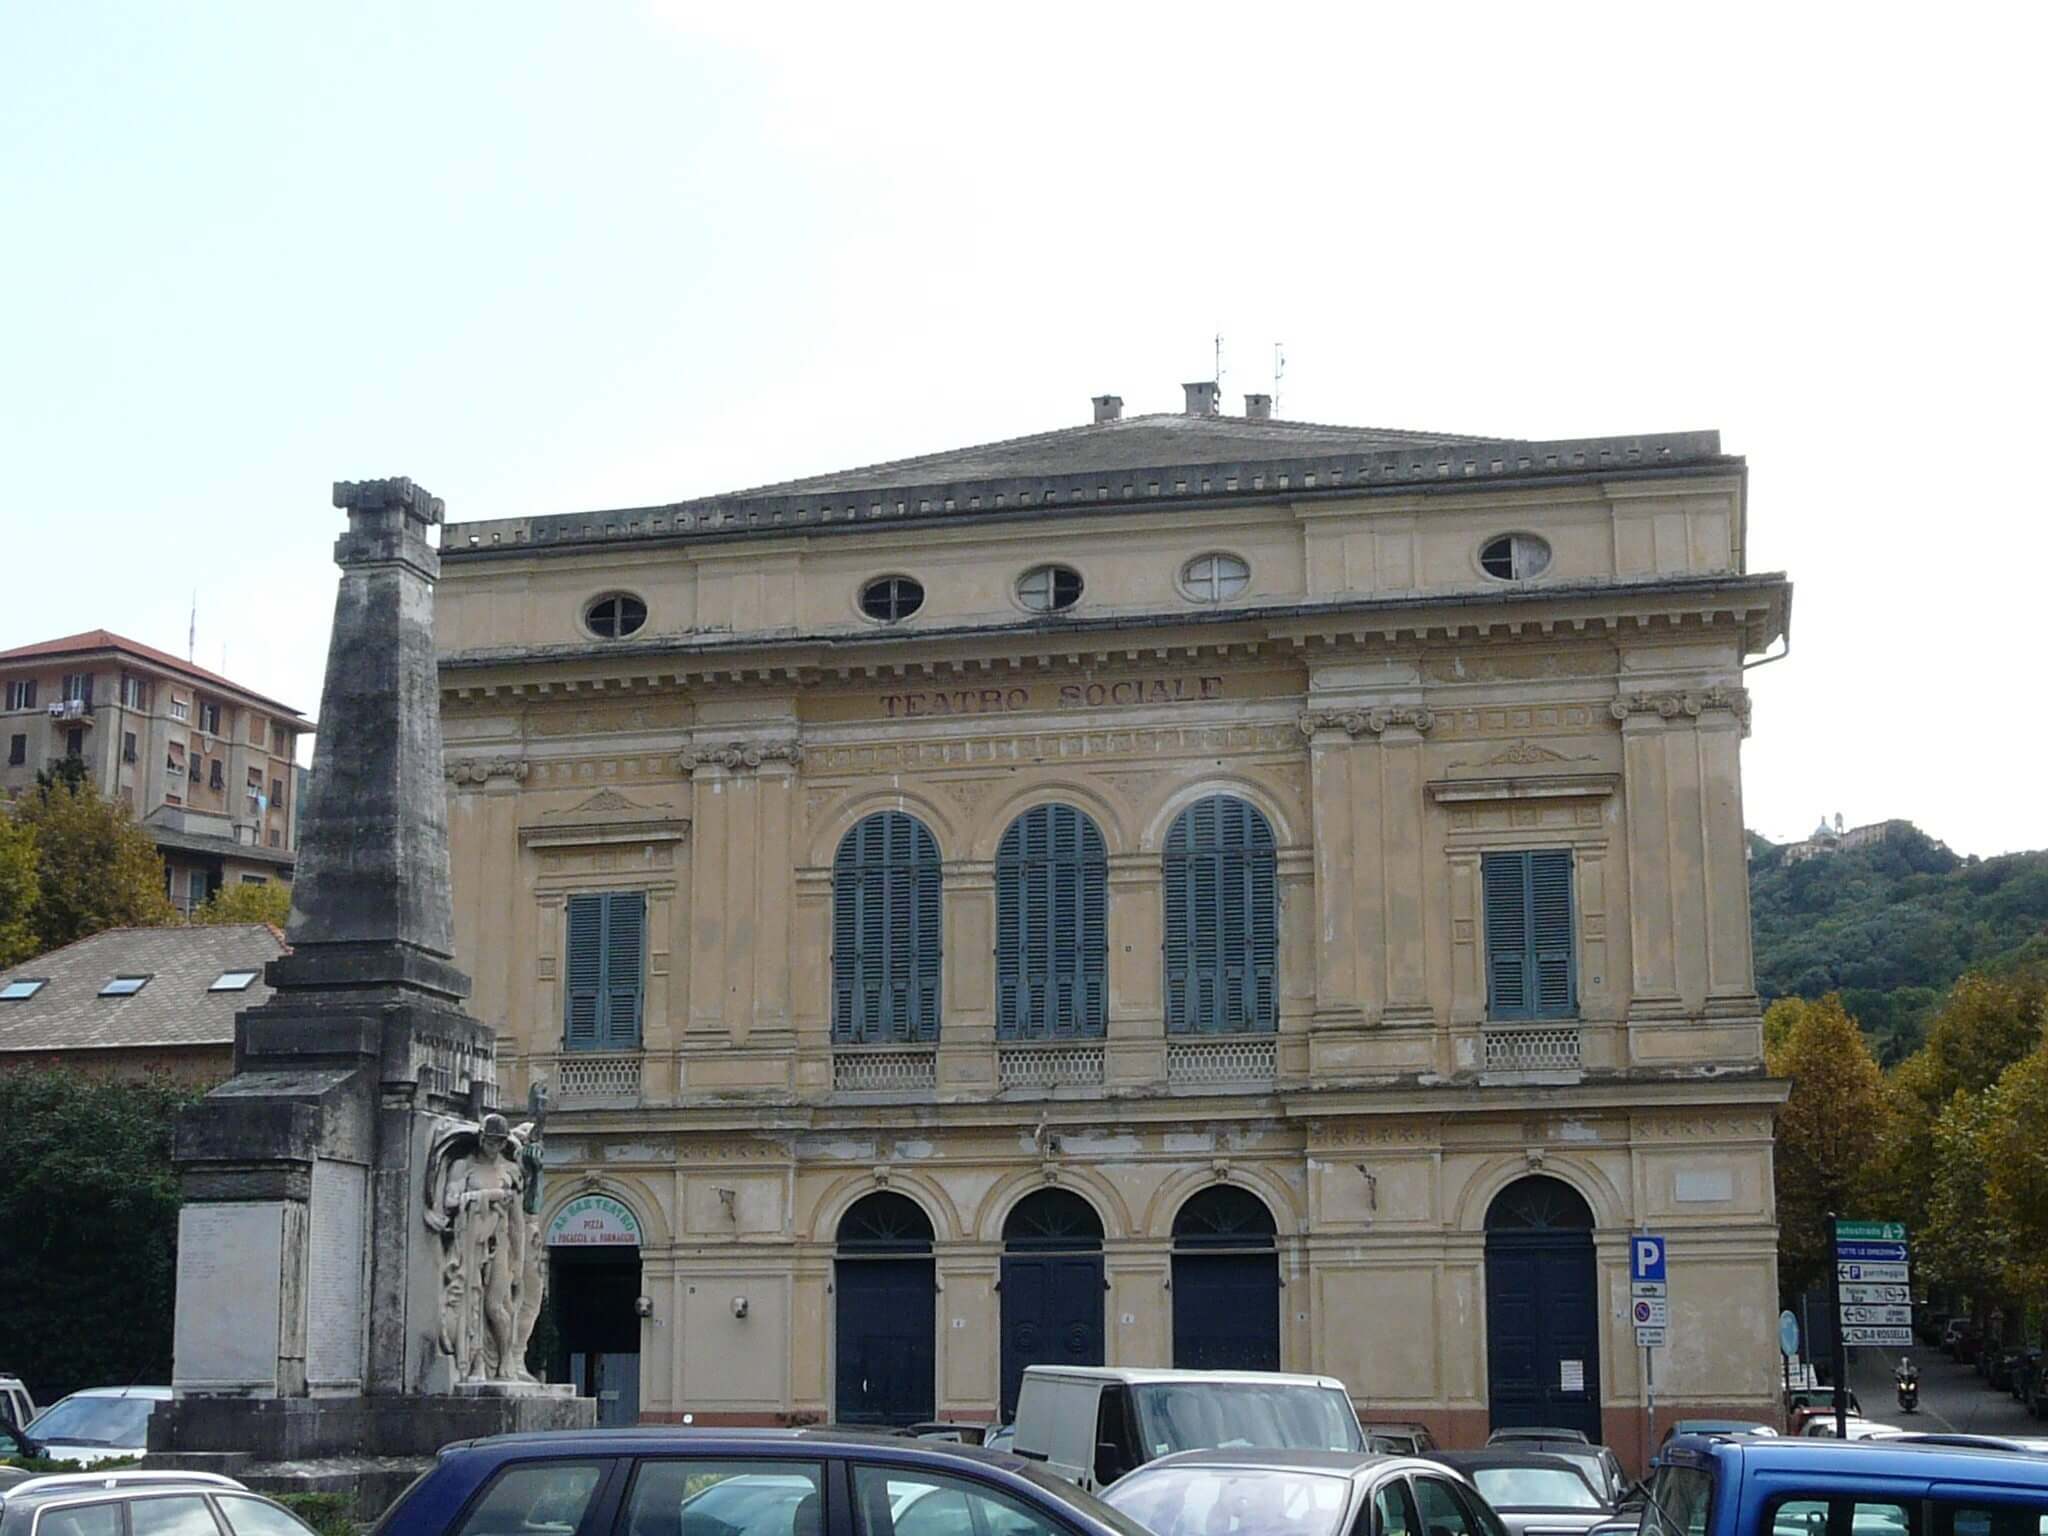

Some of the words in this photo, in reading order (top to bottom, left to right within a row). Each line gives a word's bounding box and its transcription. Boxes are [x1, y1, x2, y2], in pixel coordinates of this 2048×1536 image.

[879, 687, 1030, 718] TEATRO
[1058, 676, 1224, 708] SOCIALE
[583, 1219, 604, 1230] PIZZA
[595, 1199, 636, 1231] TEATRO
[1637, 1240, 1660, 1277] P
[1851, 1266, 1860, 1279] P
[1863, 1268, 1905, 1280] parcheggio
